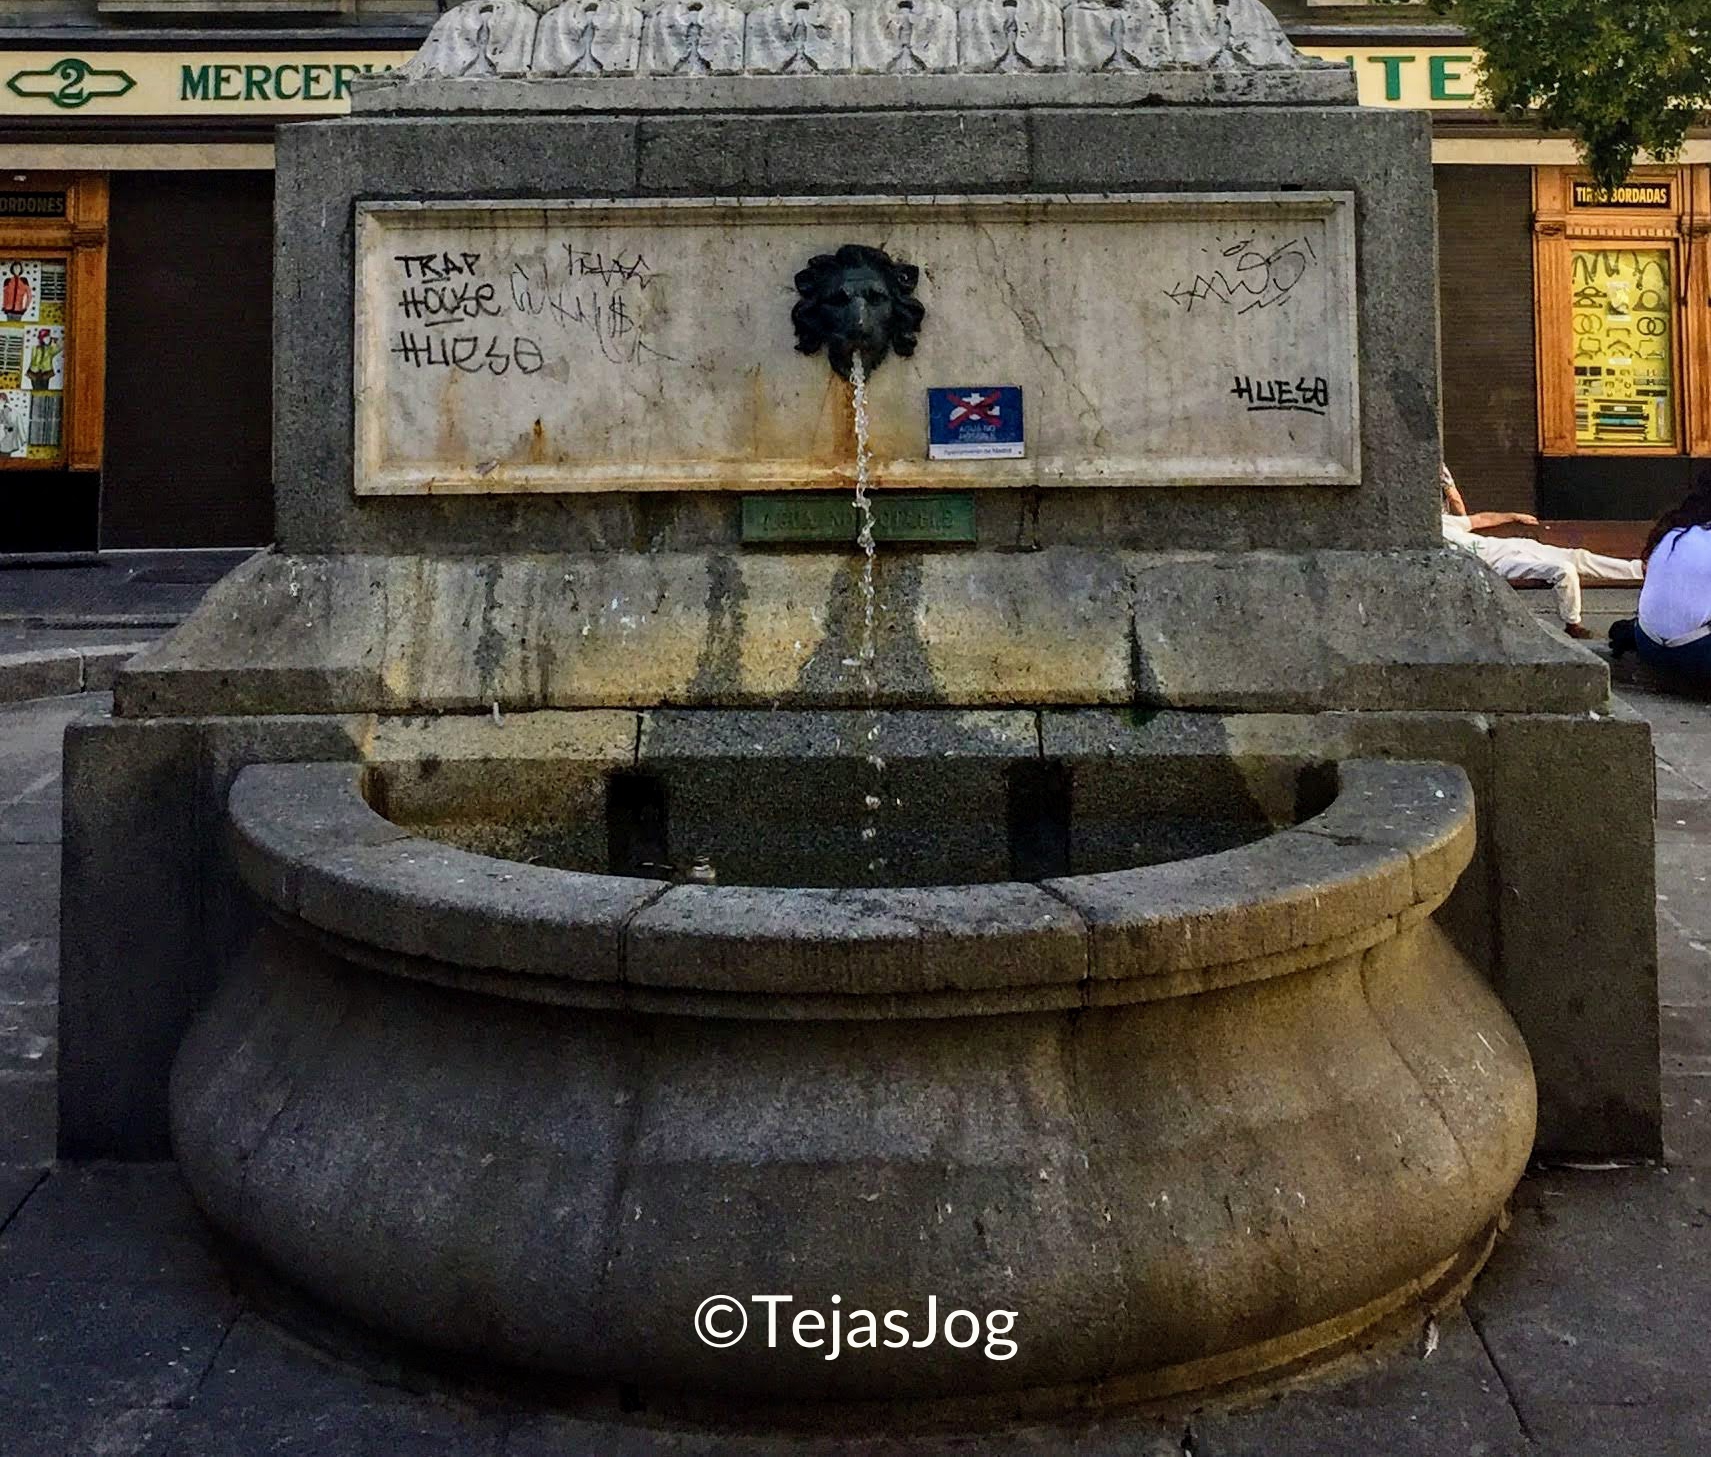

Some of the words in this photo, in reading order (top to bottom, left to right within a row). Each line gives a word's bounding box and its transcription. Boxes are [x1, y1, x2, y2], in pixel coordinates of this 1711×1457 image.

[58, 66, 85, 101] 2
[181, 64, 392, 101] MERCER
[394, 251, 481, 279] TRAP
